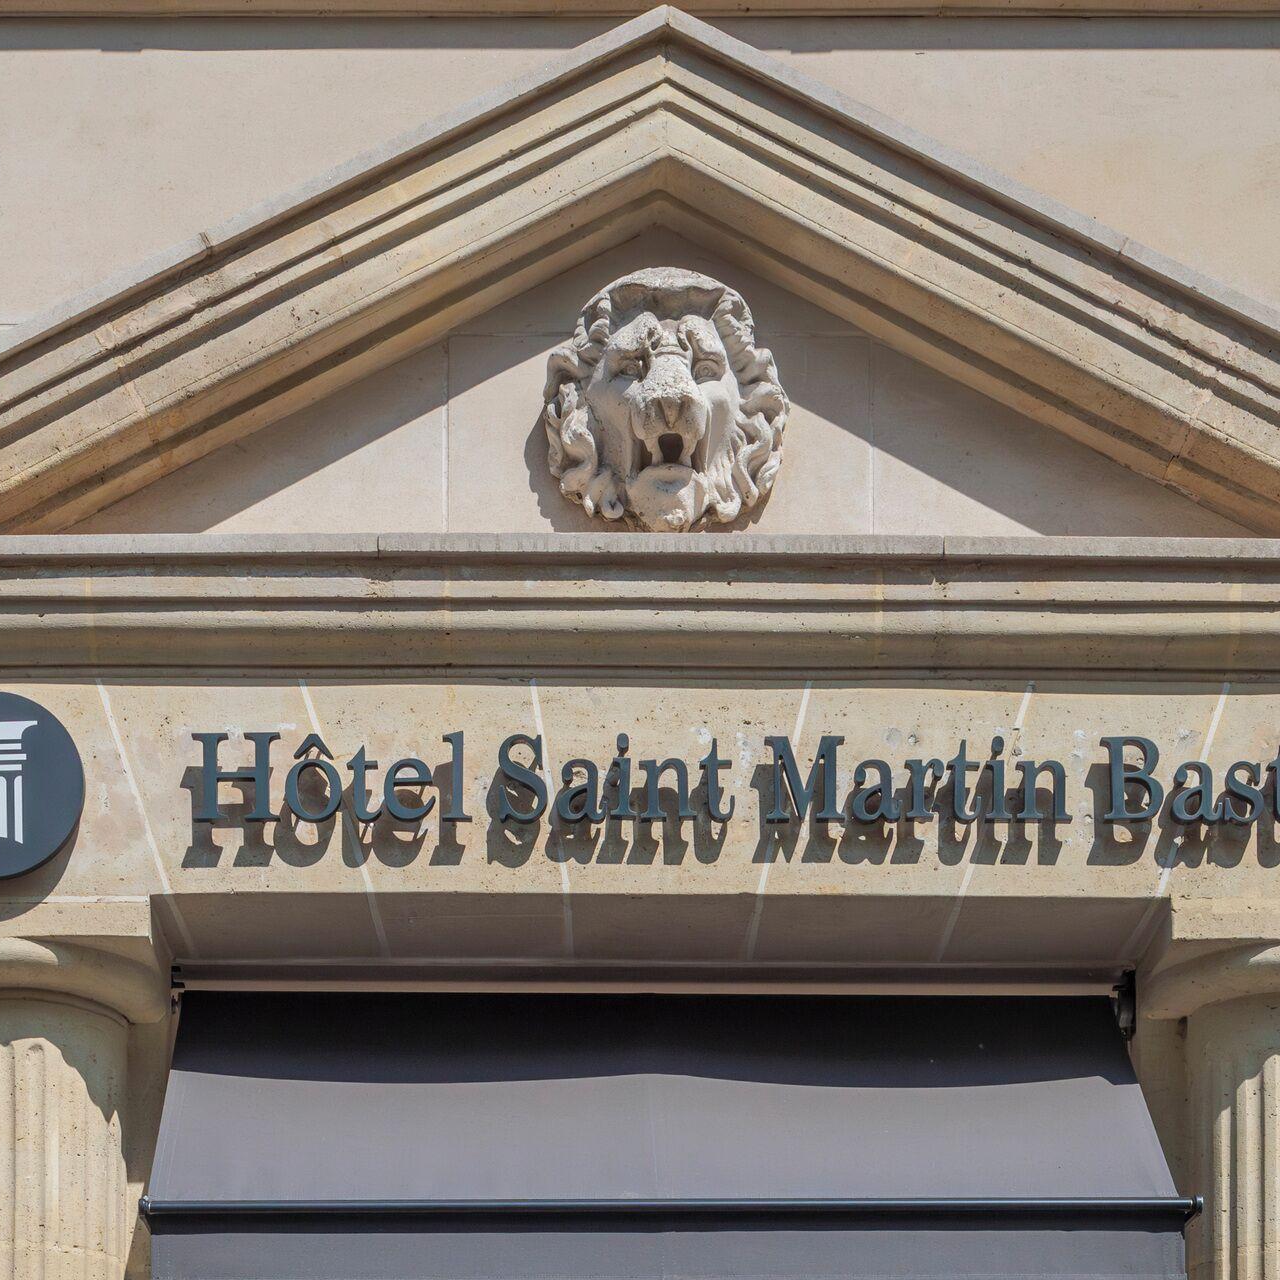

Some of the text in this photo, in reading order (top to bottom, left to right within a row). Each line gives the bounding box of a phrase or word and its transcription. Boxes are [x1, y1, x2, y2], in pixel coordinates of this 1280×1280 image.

[191, 731, 473, 823] Hôtel
[498, 732, 735, 825] Saint
[764, 735, 1073, 823] Martin
